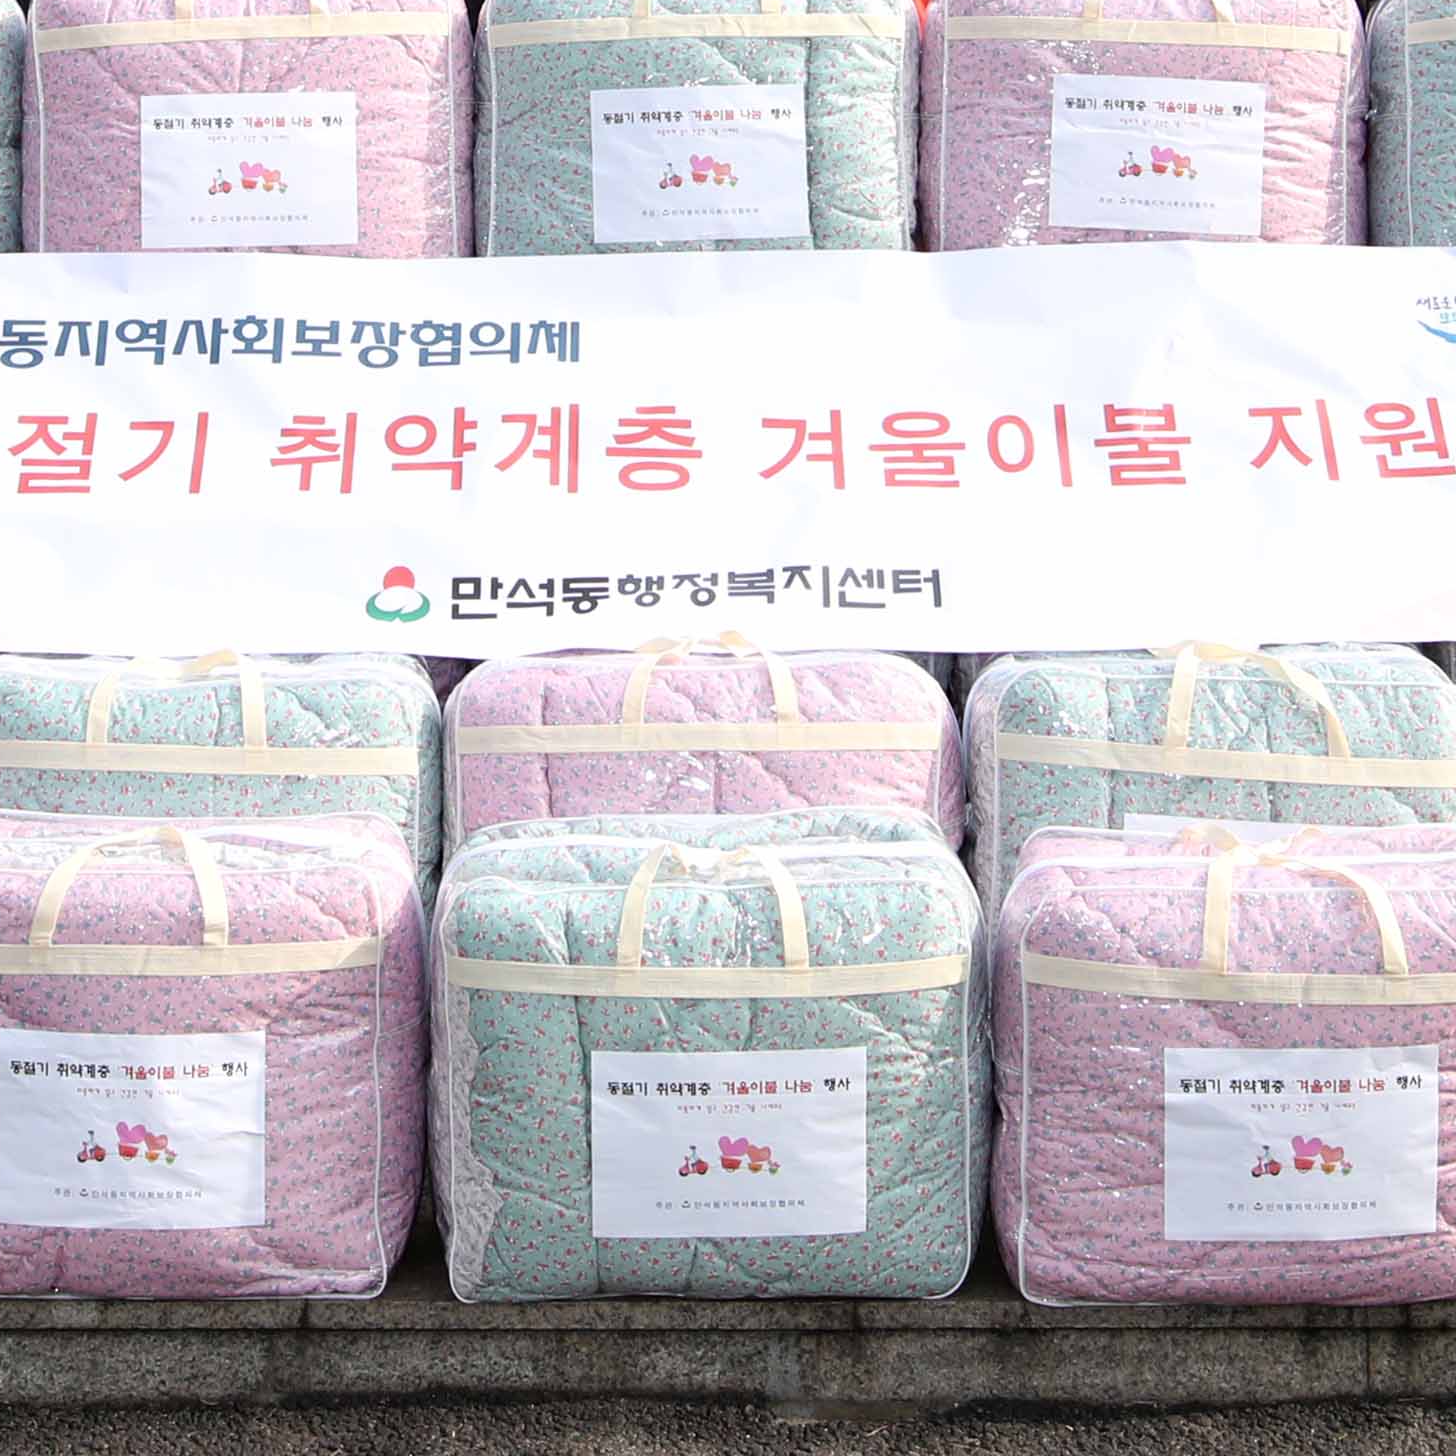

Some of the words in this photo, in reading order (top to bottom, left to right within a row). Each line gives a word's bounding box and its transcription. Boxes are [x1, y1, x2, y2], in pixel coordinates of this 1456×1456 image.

[269, 403, 703, 494] 취약계층
[758, 403, 1192, 490] 겨울이불
[1248, 397, 1456, 482] 지원
[451, 565, 941, 620] 만석동행정복지센터
[10, 1060, 49, 1077] 동절기
[56, 1063, 110, 1078] 취약계층
[222, 1061, 248, 1077] 행사
[608, 1082, 647, 1096] 동절기
[656, 1082, 711, 1096] 취약계층
[824, 1077, 850, 1092] 행사
[1180, 1079, 1220, 1094] 동절기
[1229, 1079, 1285, 1093] 취약계층
[1396, 1075, 1422, 1090] 행사
